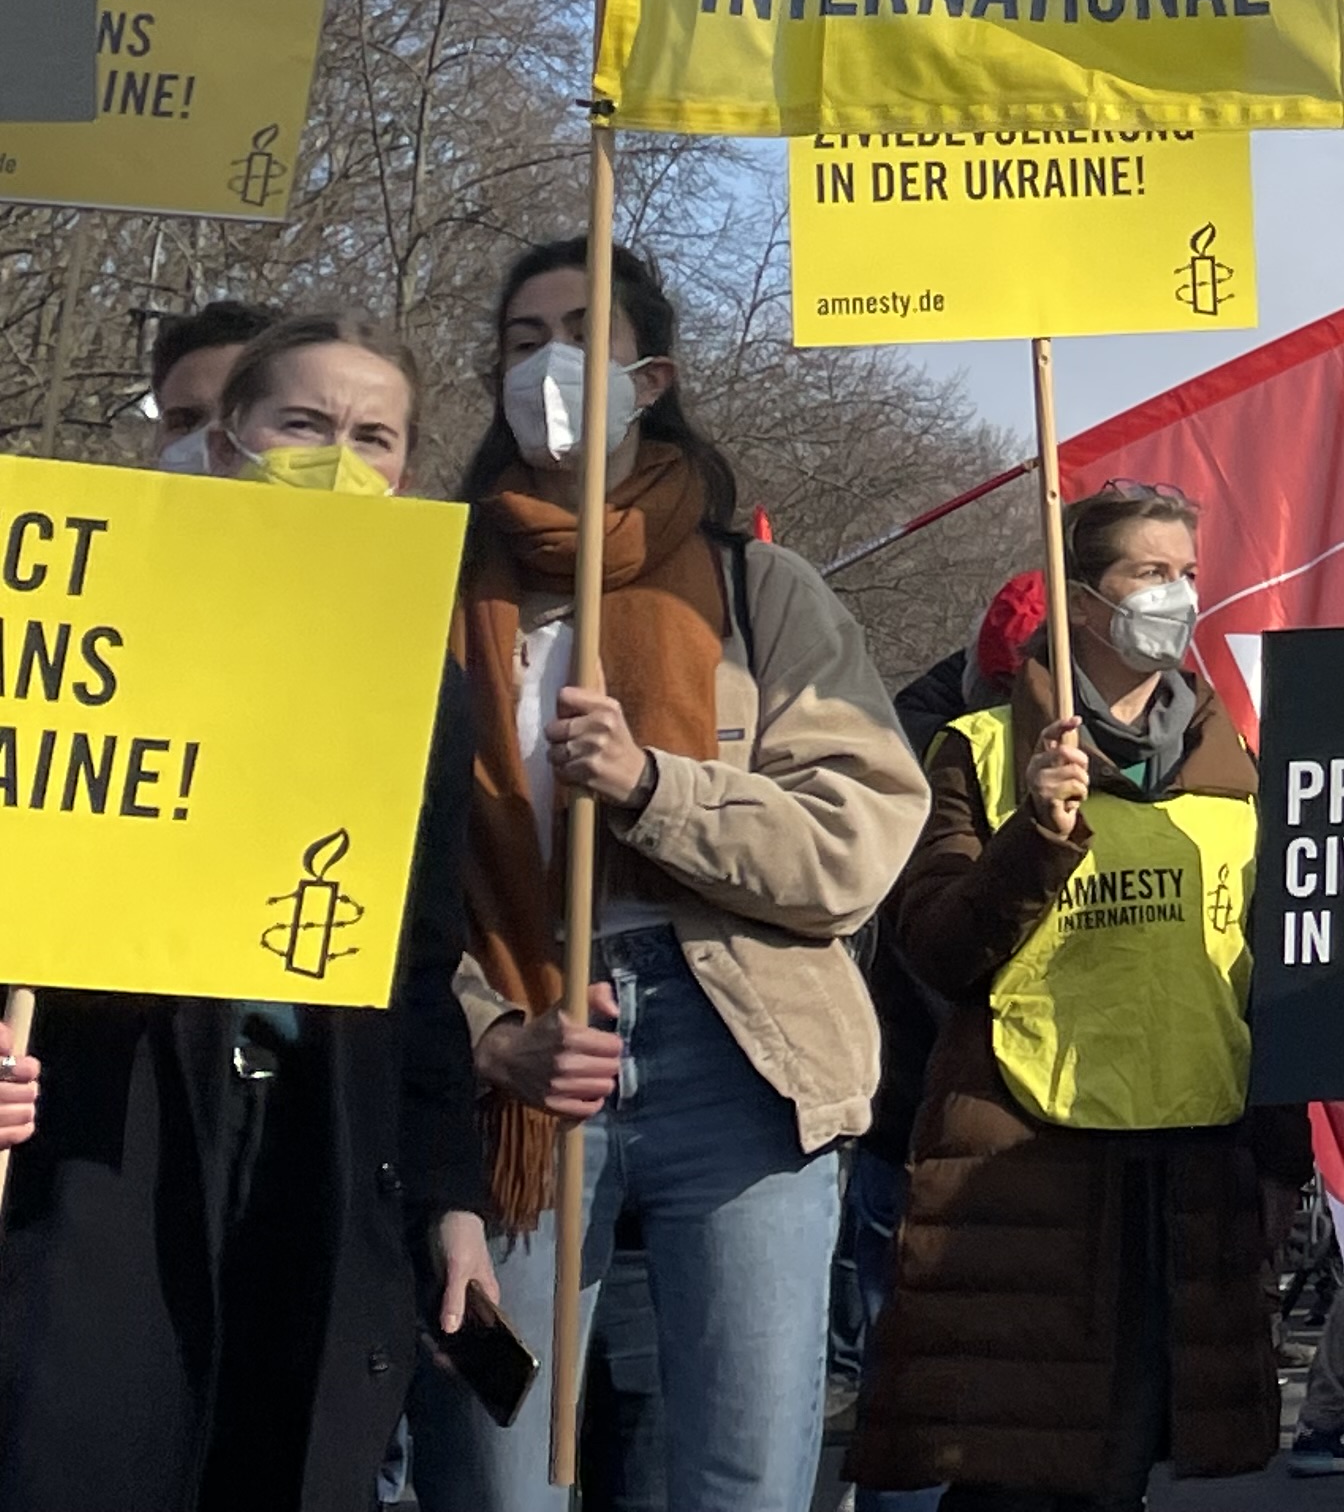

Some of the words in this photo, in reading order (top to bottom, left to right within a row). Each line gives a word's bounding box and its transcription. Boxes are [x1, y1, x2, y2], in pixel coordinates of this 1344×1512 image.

[815, 161, 855, 204] IN
[871, 160, 949, 203] DER
[964, 155, 1146, 201] UKRAINE!
[816, 289, 946, 318] amnesty.de
[1057, 868, 1184, 912] AMNESTY
[1057, 903, 1186, 933] INTERNATIONAL
[1283, 910, 1332, 965] IN
